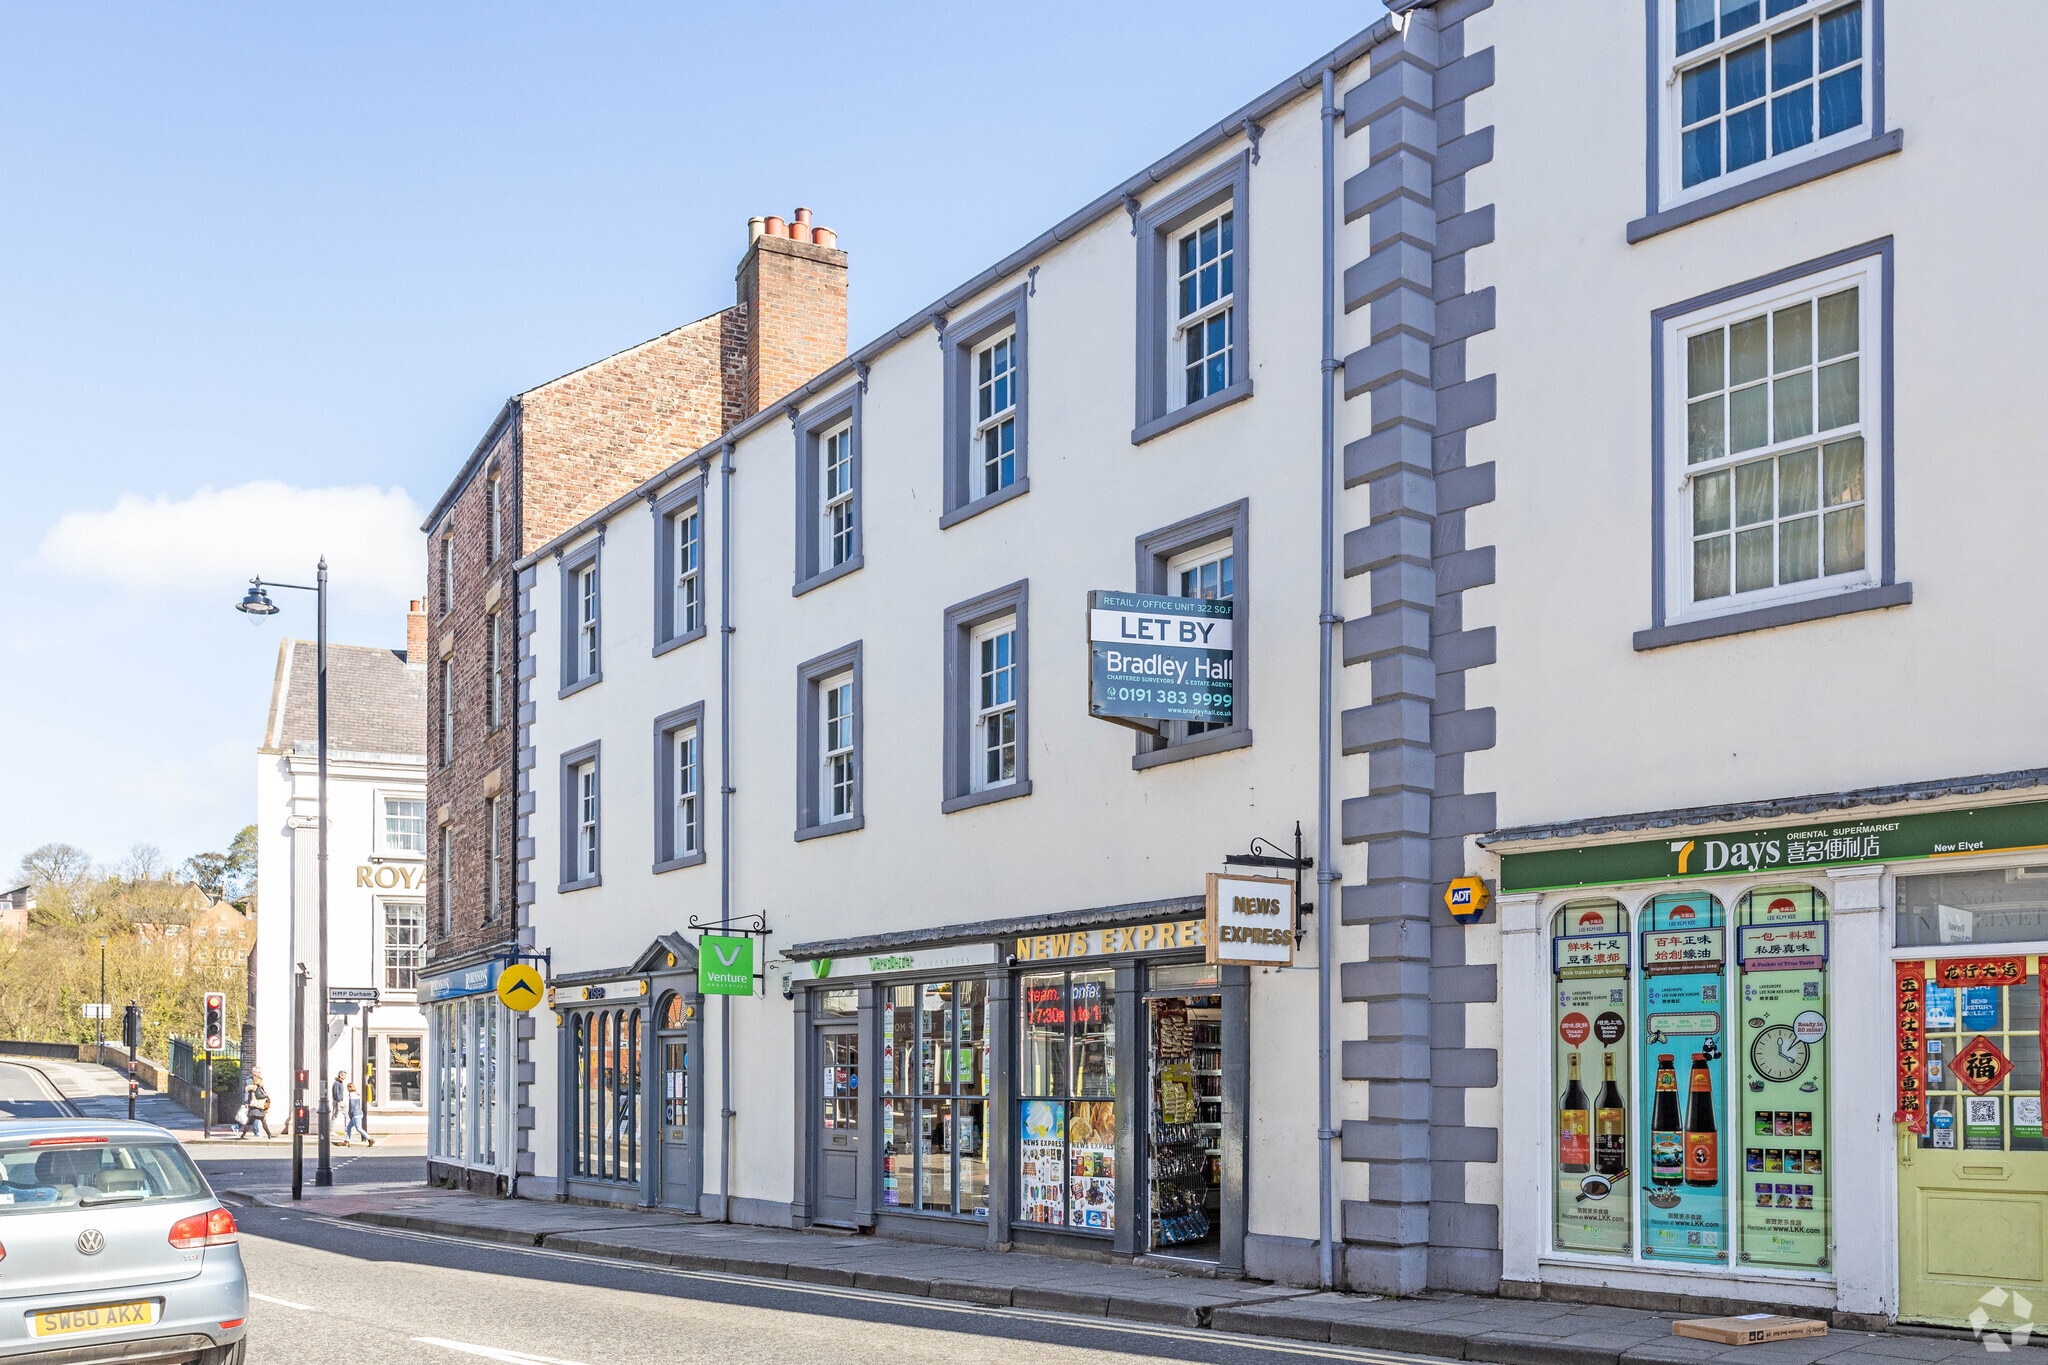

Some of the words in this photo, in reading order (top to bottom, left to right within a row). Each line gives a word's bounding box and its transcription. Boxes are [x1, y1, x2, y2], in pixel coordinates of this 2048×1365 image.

[1103, 596, 1133, 607] RETAIL
[1142, 601, 1173, 610] OFFICE
[1175, 603, 1195, 612] UNIT
[1197, 605, 1212, 613] 322
[1121, 616, 1171, 640] LET
[1179, 620, 1215, 644] BY
[1107, 650, 1188, 684] Bradley
[1195, 657, 1233, 680] Hall
[1107, 674, 1141, 682] CHARTERED
[1119, 687, 1152, 703] 0191
[1156, 690, 1187, 704] 383
[1192, 692, 1233, 707] 9999
[1168, 707, 1232, 716] www.bradleyhall.co.uk
[1787, 830, 1828, 840] ORIENTAL
[1833, 823, 1900, 836] SUPERMARKET
[1787, 835, 1880, 864] 喜多便利店
[1934, 843, 1956, 853] New
[1958, 840, 1984, 852] Elvet
[1671, 839, 1695, 874] 7
[1703, 839, 1780, 871] Days
[1452, 890, 1471, 902] ADT
[1233, 895, 1280, 915] NEWS
[1220, 925, 1293, 946] EXPRESS
[1654, 935, 1712, 947] 百年正味
[1748, 930, 1816, 941] 一包一料理
[1017, 931, 1088, 960] NEWS
[1567, 940, 1620, 952] 鮮味十足
[1755, 943, 1810, 954] 私房真味
[1567, 953, 1620, 965] 豆香濃郁
[1655, 948, 1711, 960] 始創蠔油
[868, 955, 913, 971] Venture
[707, 971, 747, 983] Venture
[1945, 962, 2018, 980] 龙行大运
[1077, 1005, 1090, 1022] to
[1966, 1053, 1996, 1080] 福
[1023, 1139, 1039, 1147] NEWS
[1584, 1214, 1624, 1222] www.LKK.com
[1675, 1220, 1719, 1228] www.LKK.com
[1773, 1225, 1820, 1234] www.LKK.com
[1780, 1238, 1794, 1246] Days
[45, 1309, 99, 1332] SW60
[106, 1303, 144, 1325] AKX
